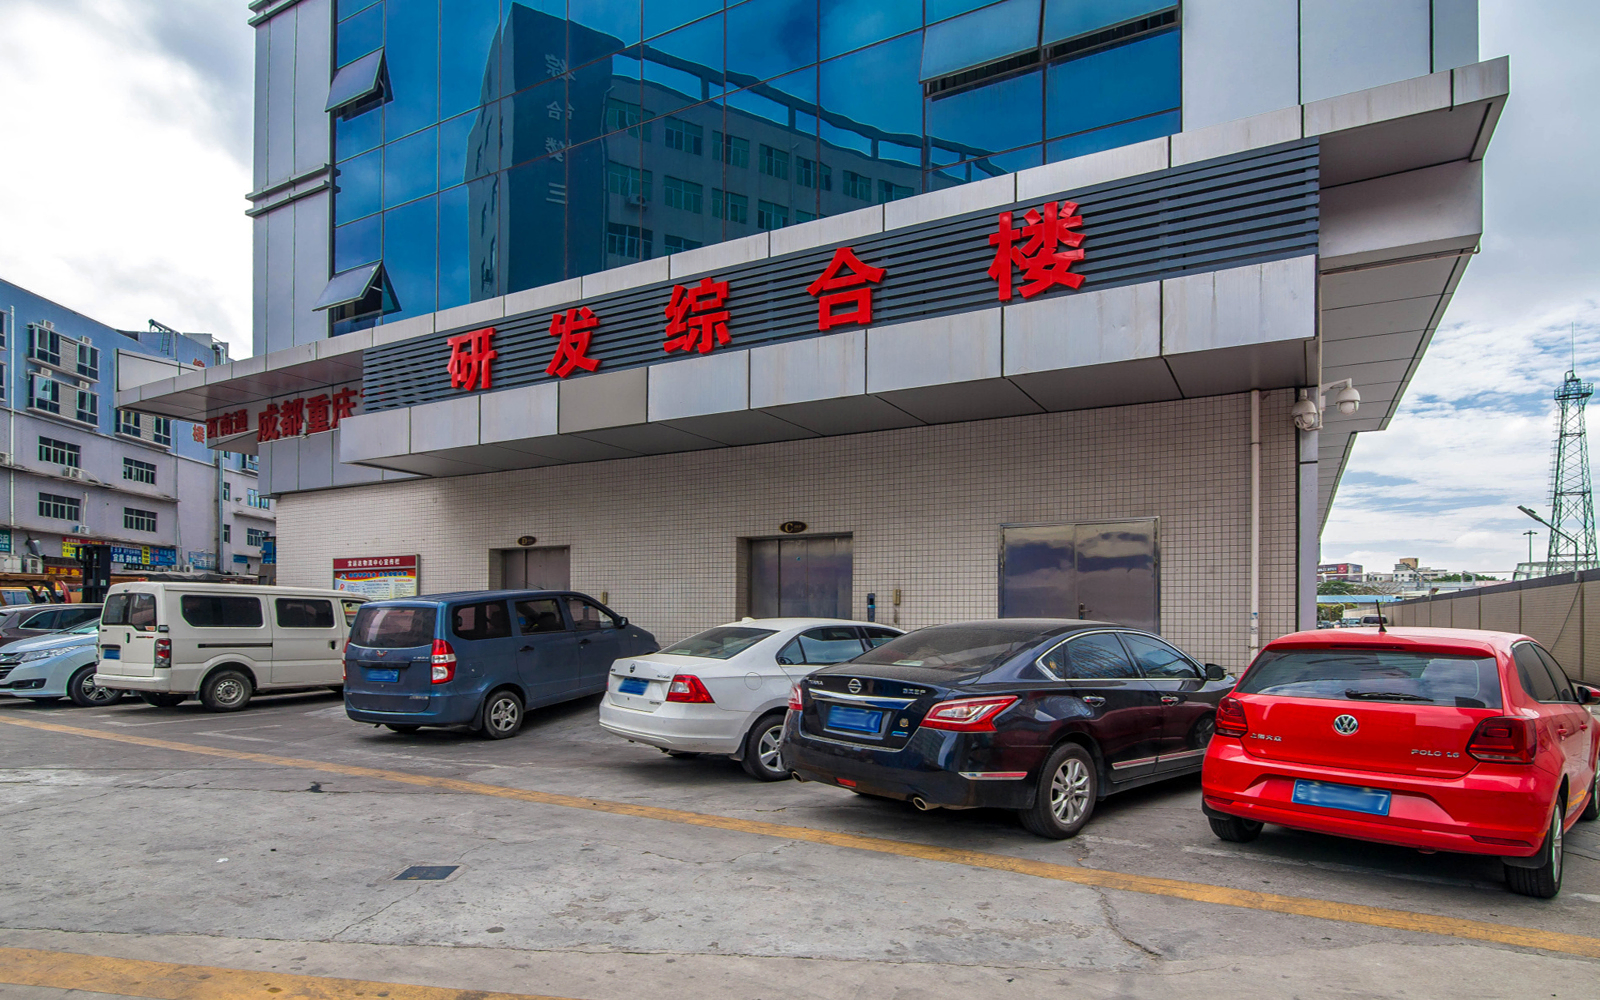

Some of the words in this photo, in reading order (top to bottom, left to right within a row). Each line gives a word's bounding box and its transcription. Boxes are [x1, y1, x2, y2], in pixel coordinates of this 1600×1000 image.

[446, 201, 1086, 391] 研发综合楼
[206, 409, 248, 438] 西南通
[257, 387, 356, 442] 成都重庆
[1411, 749, 1442, 757] POLO
